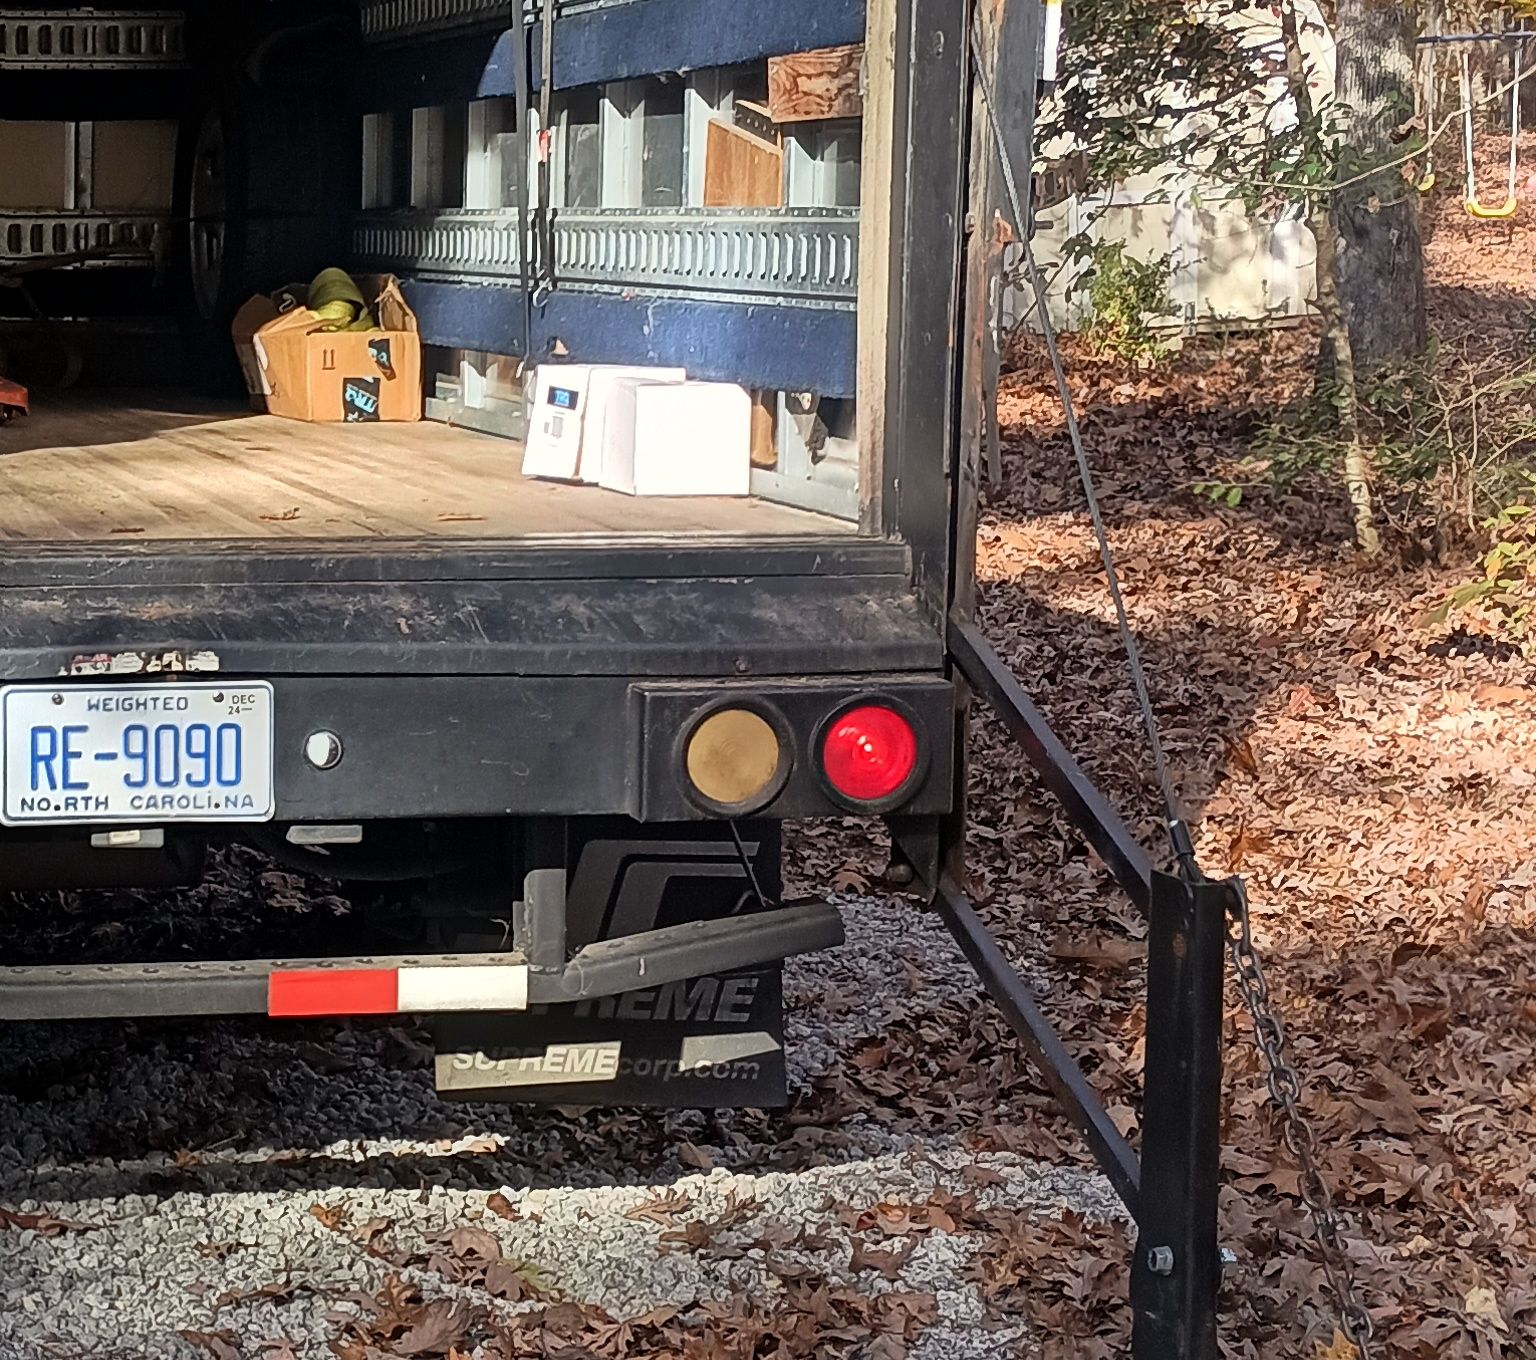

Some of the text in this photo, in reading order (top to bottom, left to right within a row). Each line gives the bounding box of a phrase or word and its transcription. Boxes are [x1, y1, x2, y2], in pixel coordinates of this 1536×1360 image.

[88, 696, 189, 712] WEIGHTED
[232, 693, 256, 705] DEC
[30, 723, 242, 790] RE-9090
